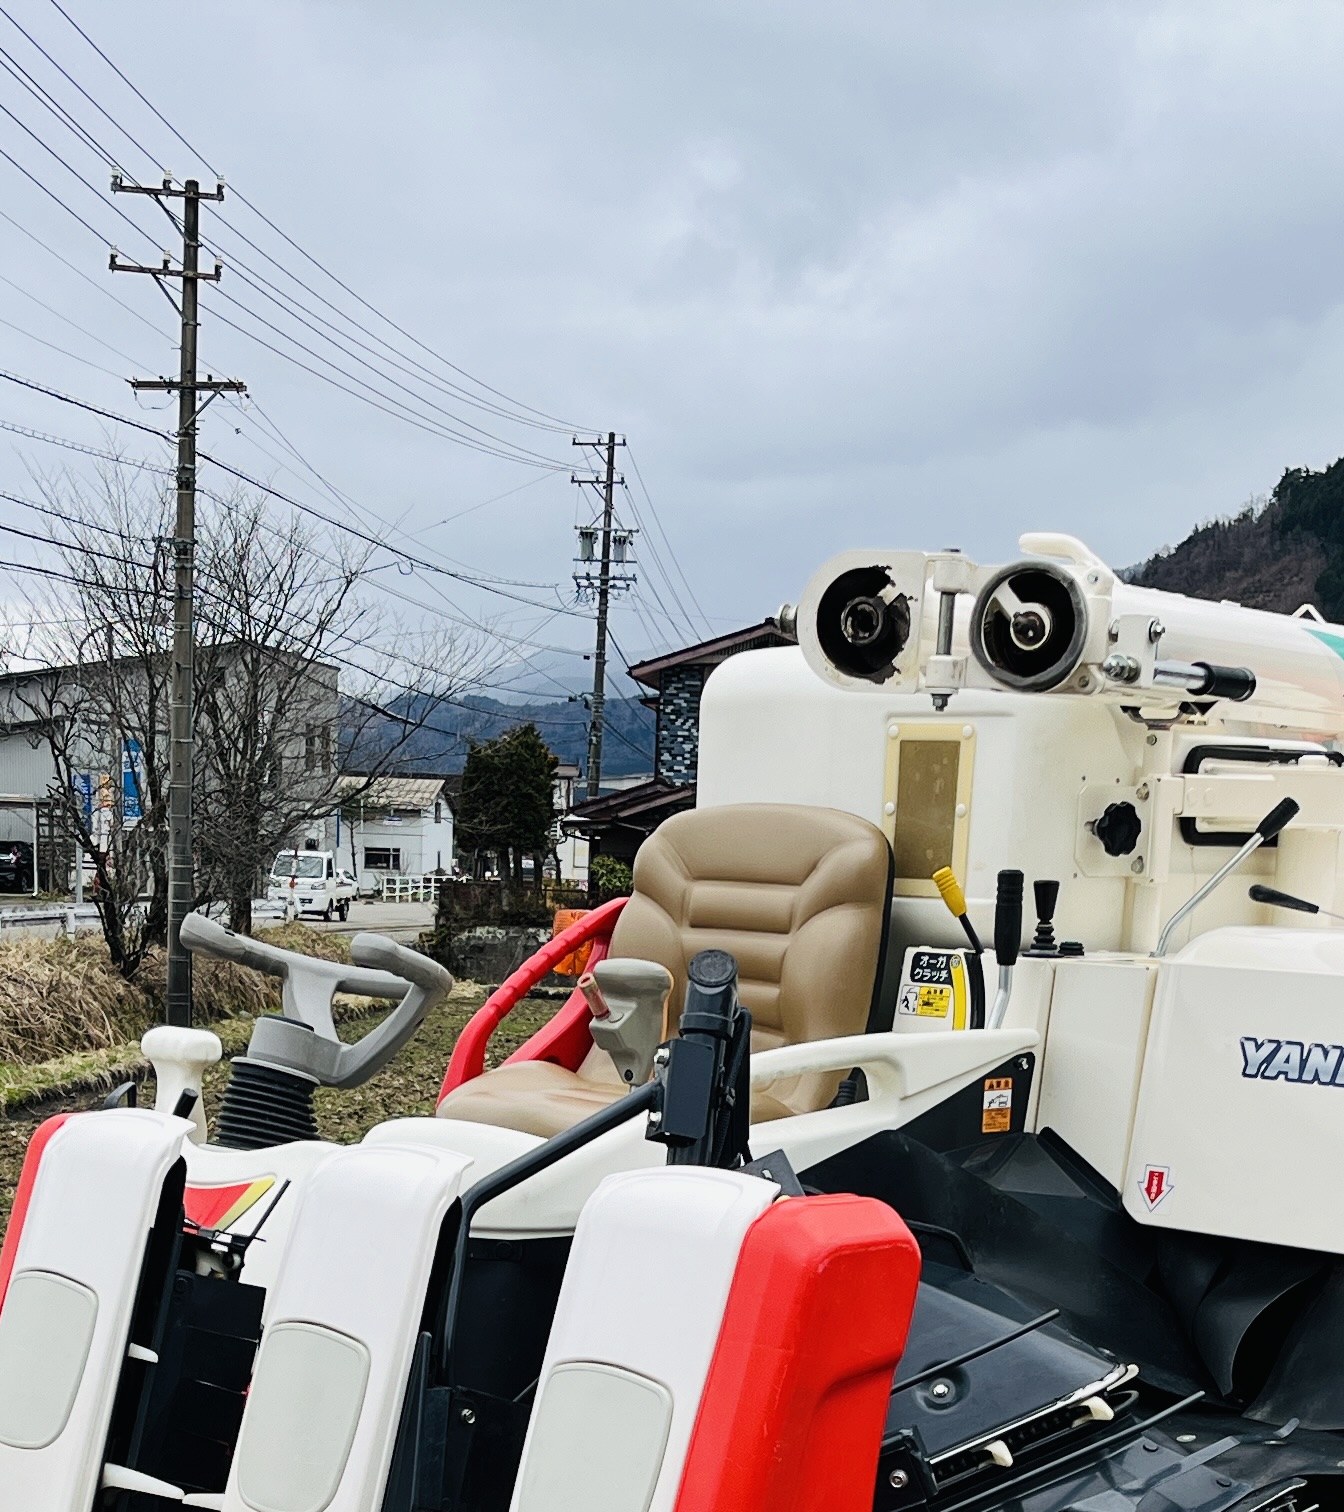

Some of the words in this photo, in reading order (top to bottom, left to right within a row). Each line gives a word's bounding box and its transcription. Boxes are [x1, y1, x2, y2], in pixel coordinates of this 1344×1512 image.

[919, 955, 947, 969] オーガ
[914, 967, 949, 982] クラッチ
